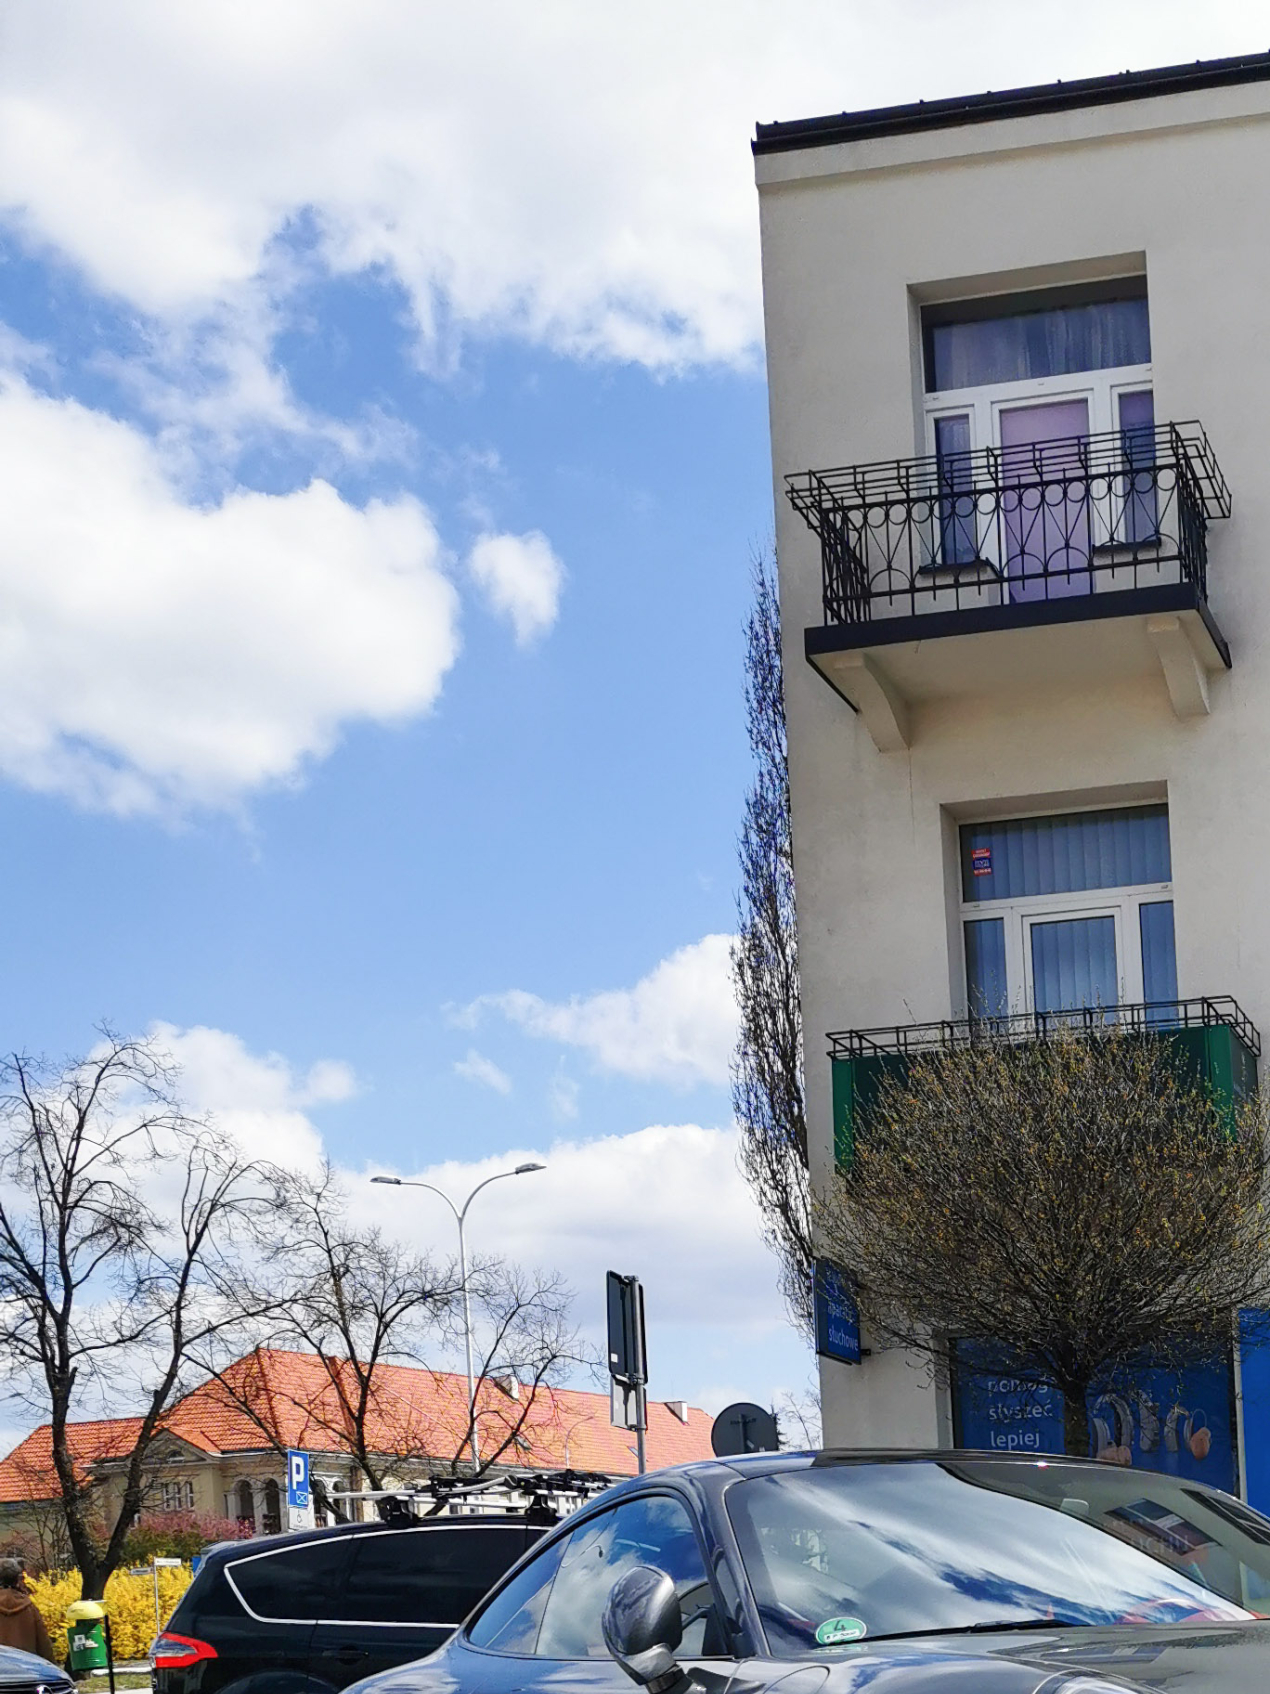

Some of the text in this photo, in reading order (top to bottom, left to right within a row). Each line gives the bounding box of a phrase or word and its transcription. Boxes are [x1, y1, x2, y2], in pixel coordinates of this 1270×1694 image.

[828, 1324, 859, 1351] słuchowe
[990, 1430, 1040, 1451] lepiej
[291, 1456, 305, 1490] P
